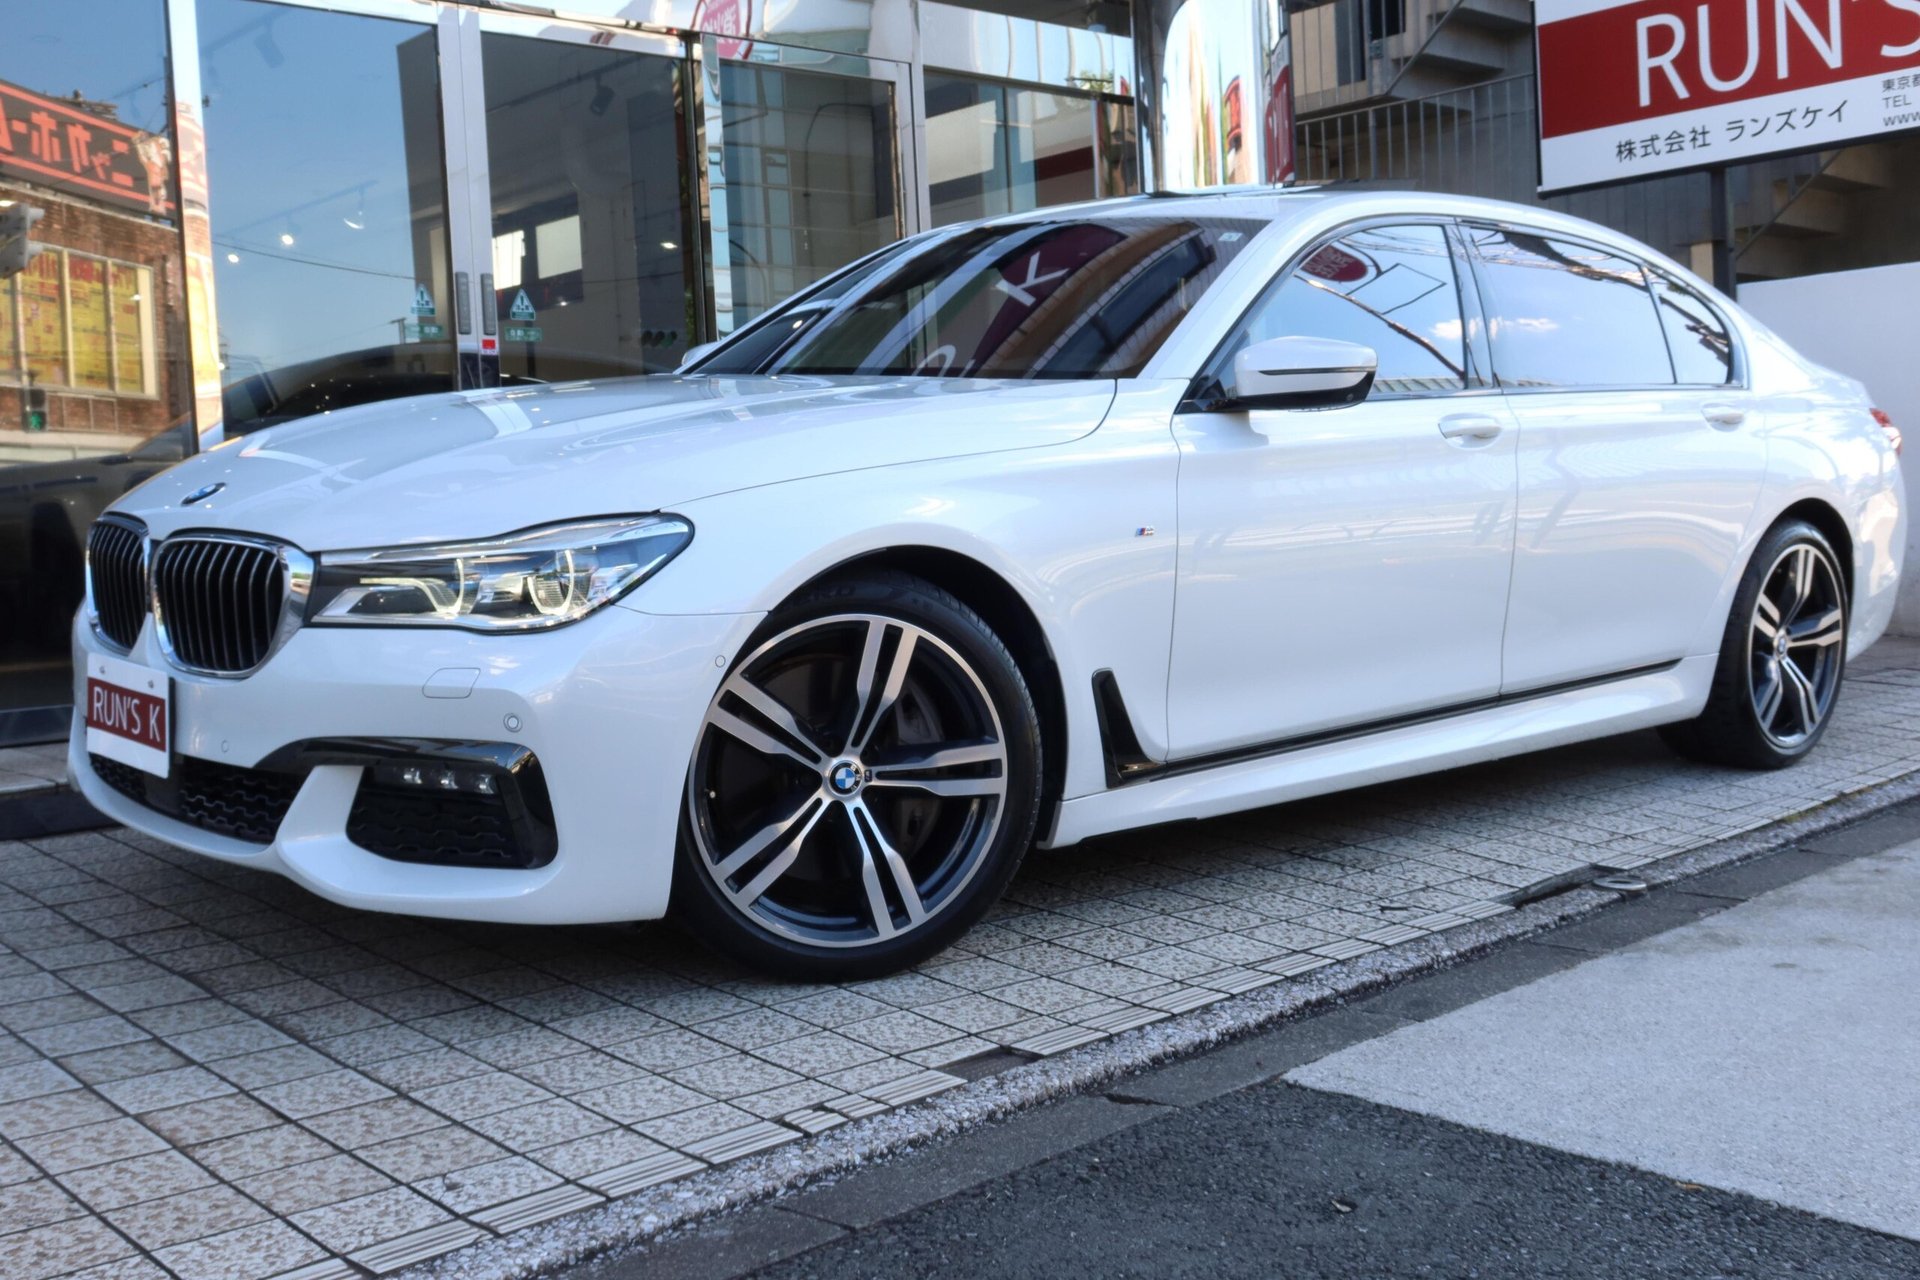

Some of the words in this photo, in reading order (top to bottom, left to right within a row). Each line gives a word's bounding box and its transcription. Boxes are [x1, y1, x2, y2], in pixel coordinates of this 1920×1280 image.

[1882, 94, 1912, 109] TEL
[1615, 125, 1711, 163] 株式会社
[1726, 100, 1849, 142] ランズケイ
[93, 685, 142, 736] RUN'S
[149, 703, 161, 743] K
